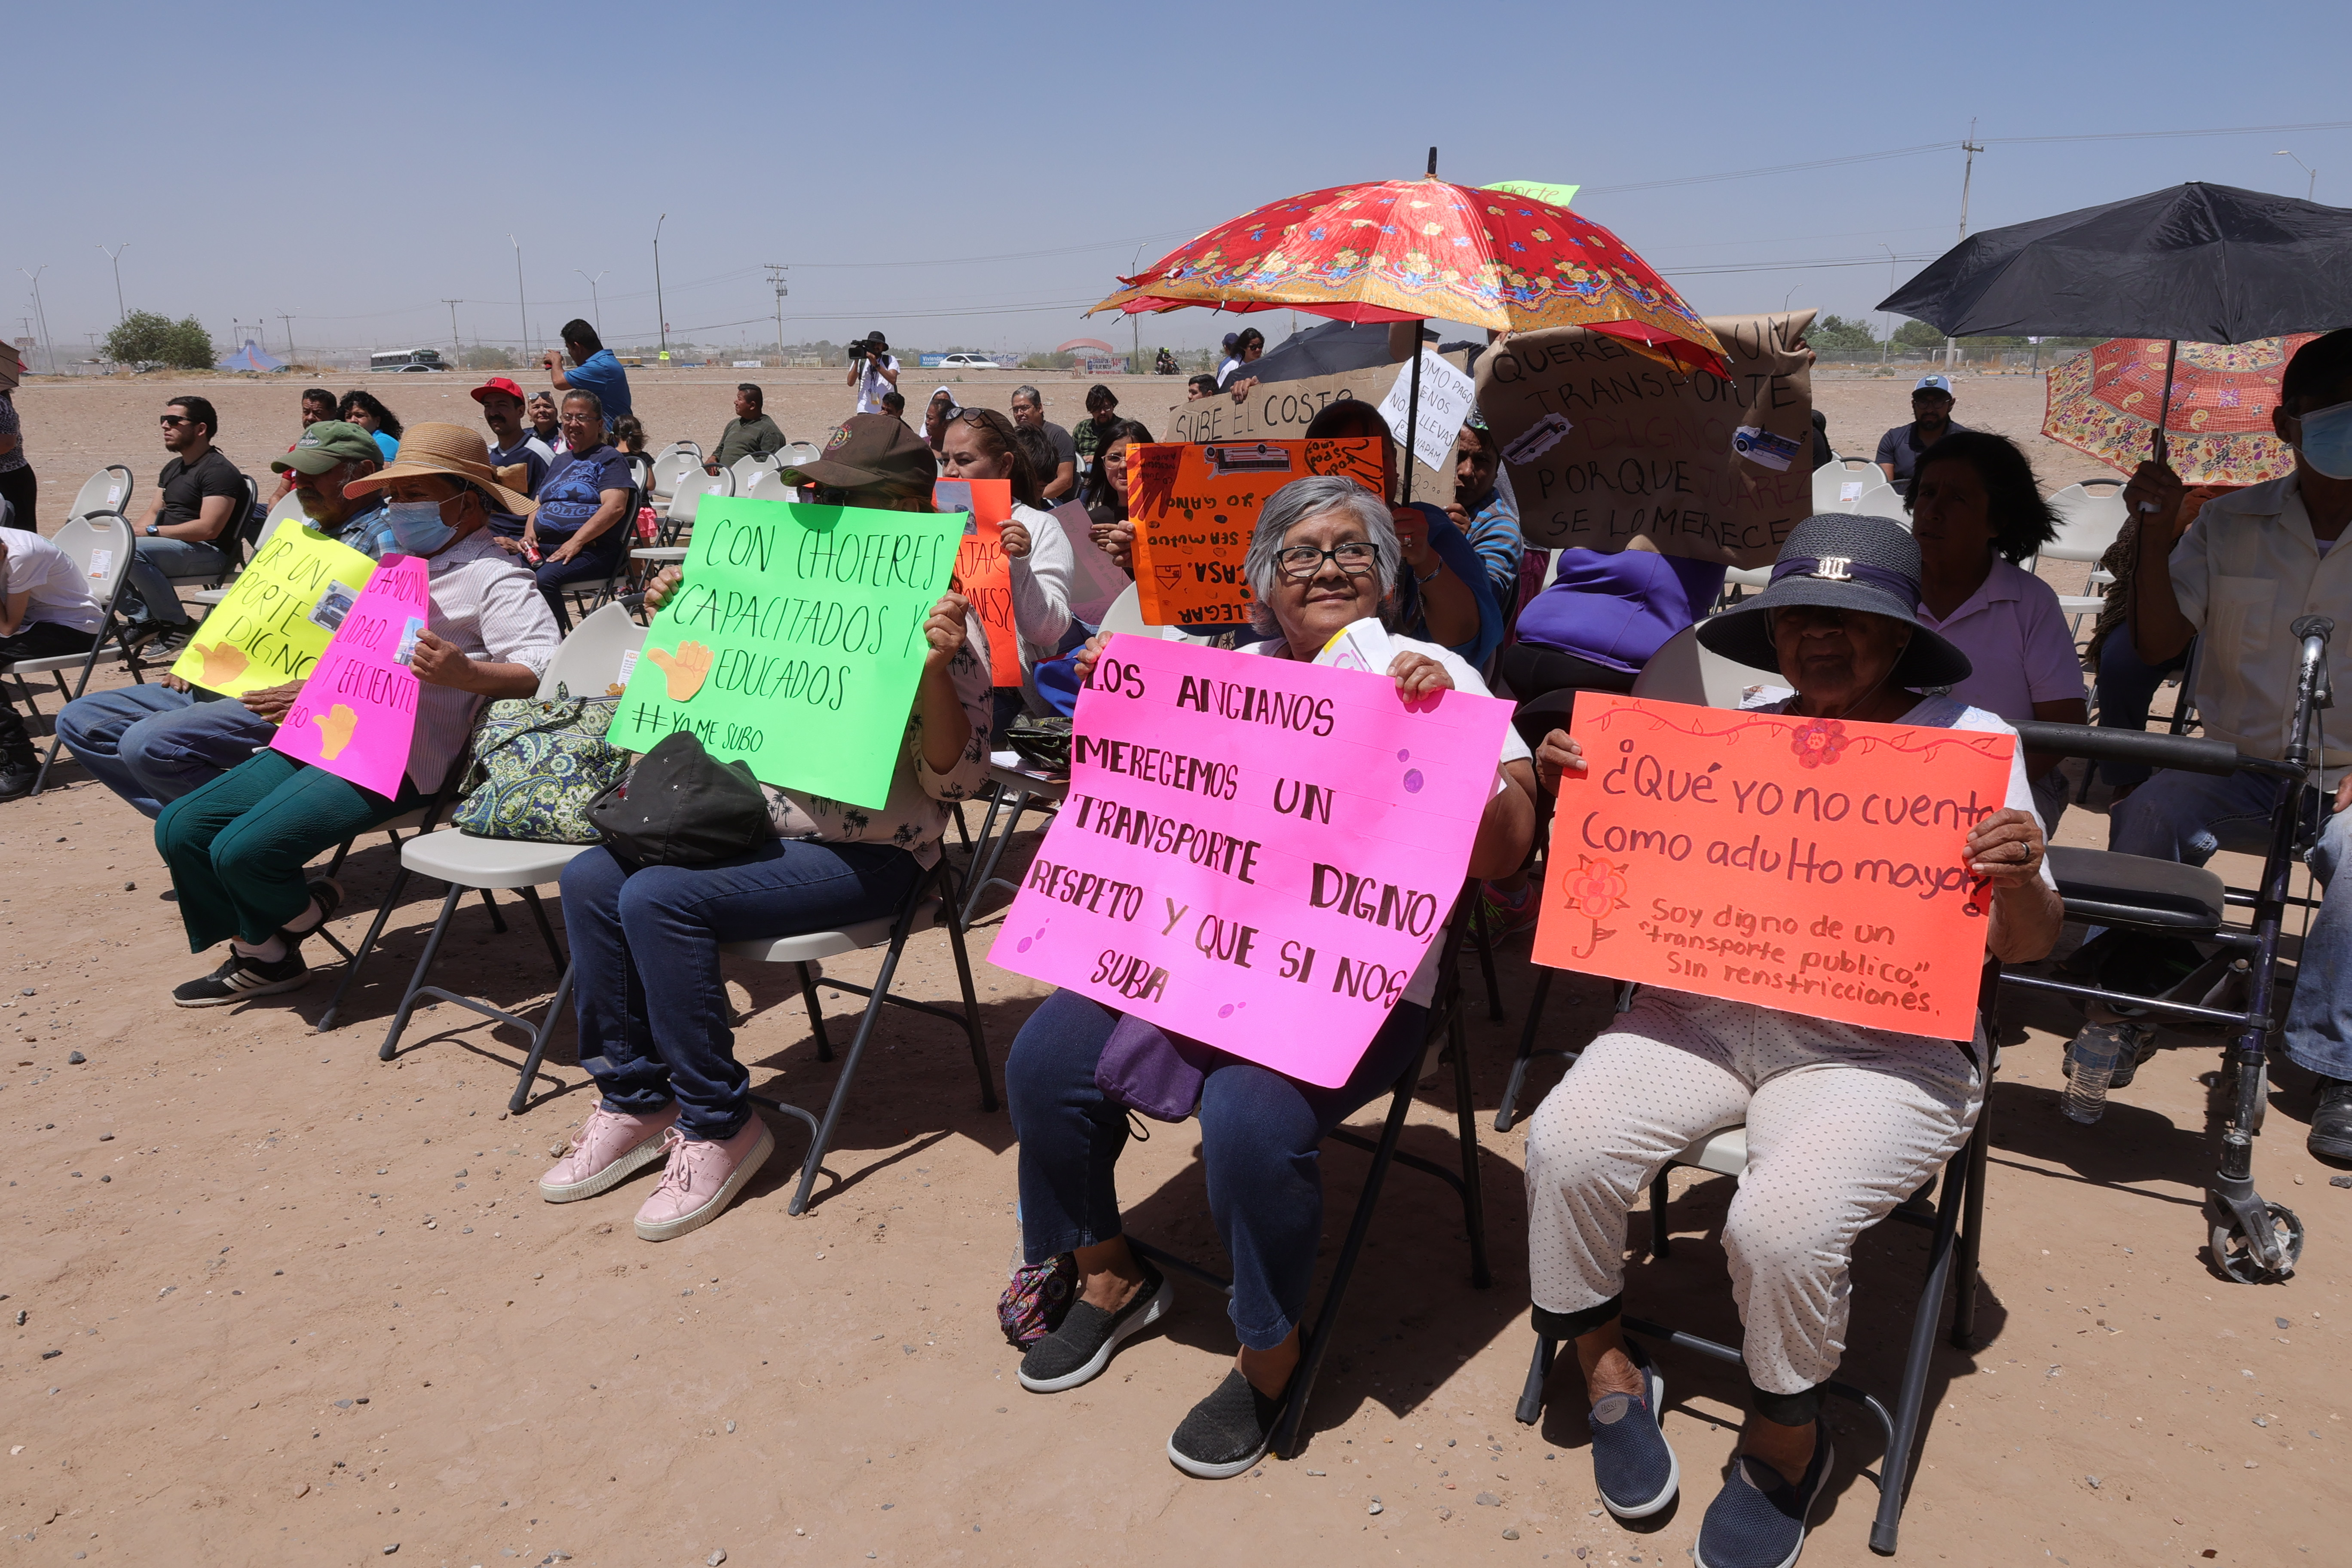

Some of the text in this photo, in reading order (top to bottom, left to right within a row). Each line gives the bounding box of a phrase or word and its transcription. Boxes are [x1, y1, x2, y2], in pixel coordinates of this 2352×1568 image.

[1734, 314, 1791, 361] UN
[1419, 380, 1451, 414] ENOS
[1420, 353, 1473, 404] OMO PAGO
[1176, 407, 1222, 442] SUBE
[1233, 403, 1254, 435] EL
[1390, 392, 1406, 412] NO
[1419, 414, 1454, 447] LLEVAS
[1582, 416, 1729, 456] DIGNO
[1538, 458, 1694, 499] PORQUE
[546, 502, 598, 516] POLICE
[1166, 495, 1217, 509] GANO
[1547, 509, 1591, 537] SE
[706, 519, 945, 591] CON CHOFERES
[1210, 531, 1239, 546] SEA
[288, 554, 332, 591] UN
[673, 584, 929, 658] CAPACITADOS Y
[322, 654, 343, 687] Y
[714, 649, 851, 711] EDUCADOS
[1083, 658, 1334, 737] LOS ANCIANOS
[695, 719, 720, 746] ME
[722, 723, 764, 752] SUBO
[1075, 734, 1336, 825] MERECEMOS UN
[1602, 739, 1723, 803] ¿Qué
[1794, 787, 1850, 823] no
[1073, 793, 1437, 944] TRANSPORTE DIGNO,
[1706, 834, 1844, 884] adulto
[1028, 859, 1408, 1010] RESPETO Y QUE SI NOS
[1651, 897, 1896, 946] Soy digno de un
[1090, 949, 1170, 1004] SUBA
